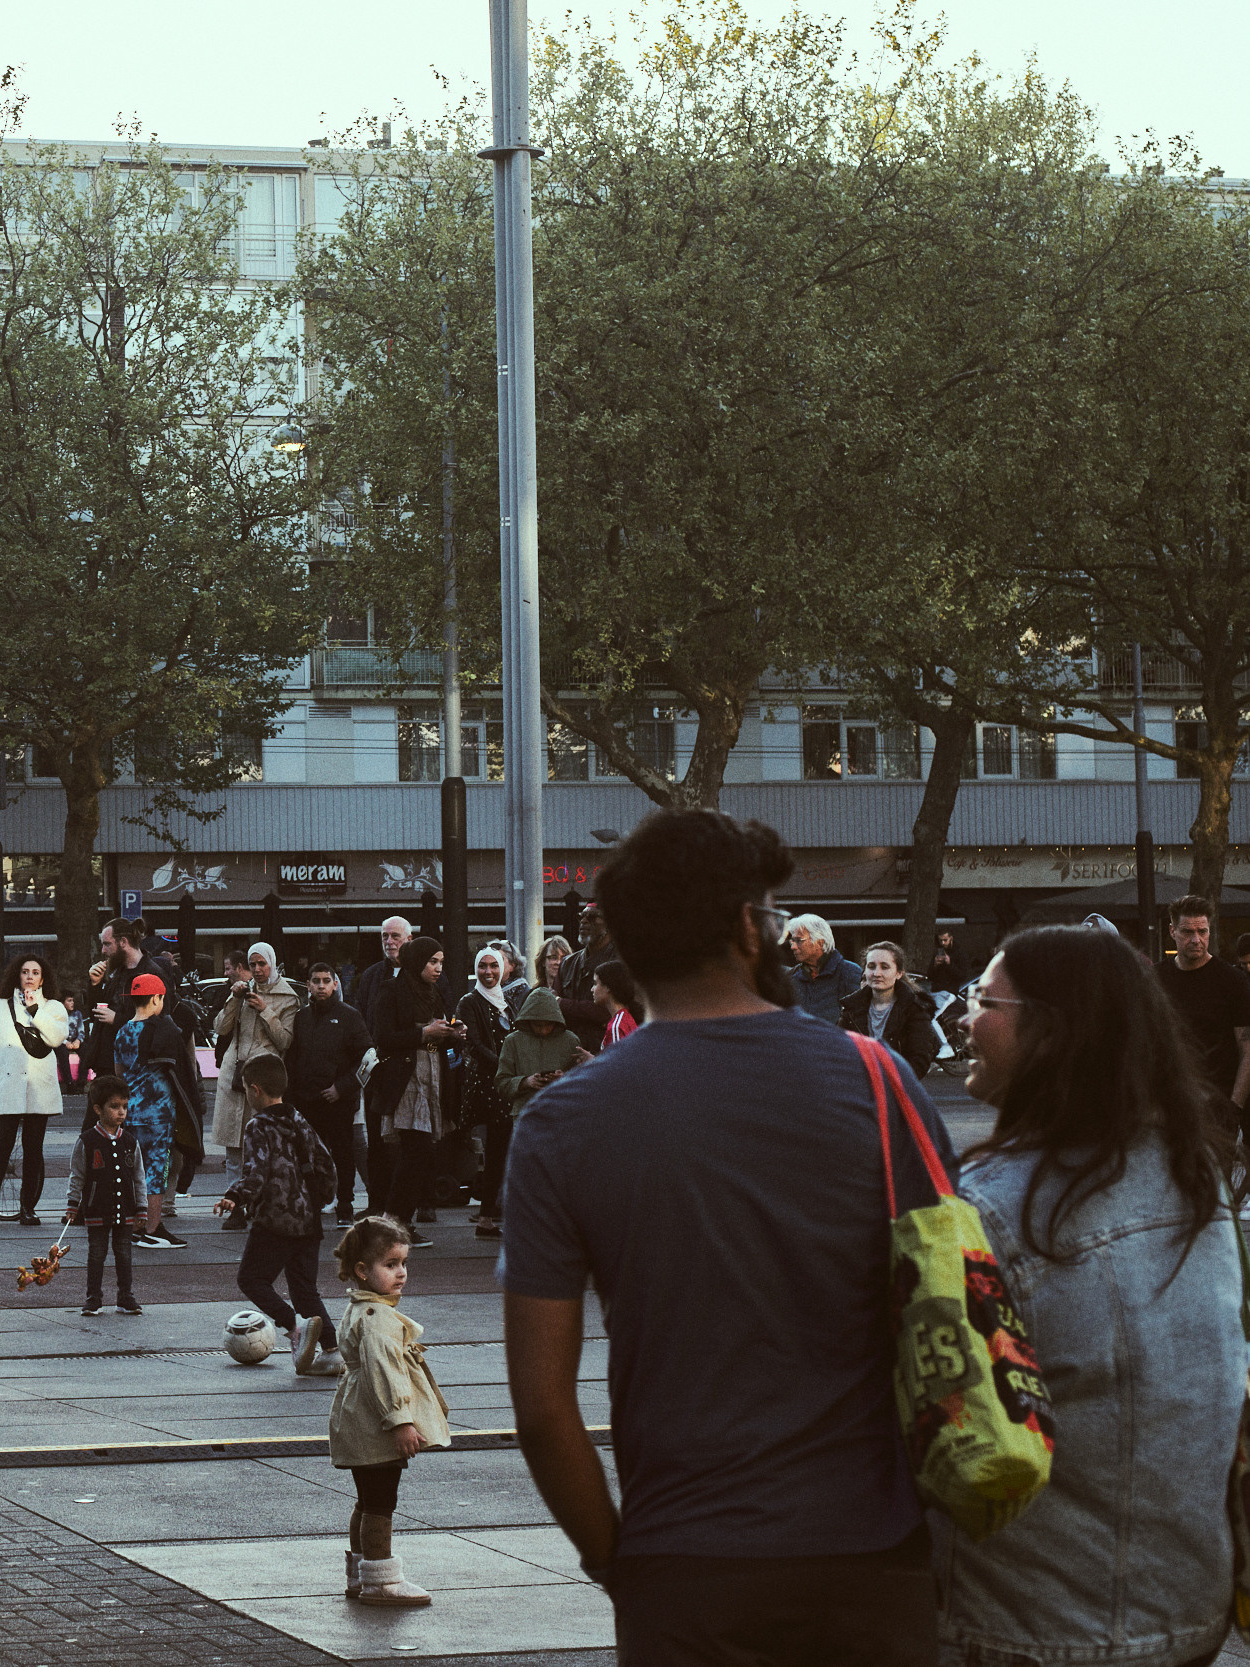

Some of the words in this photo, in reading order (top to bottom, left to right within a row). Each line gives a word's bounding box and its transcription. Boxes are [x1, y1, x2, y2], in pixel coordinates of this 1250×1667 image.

[280, 864, 346, 882] meram
[542, 866, 569, 883] BQ
[575, 866, 587, 883] &
[125, 892, 137, 909] P
